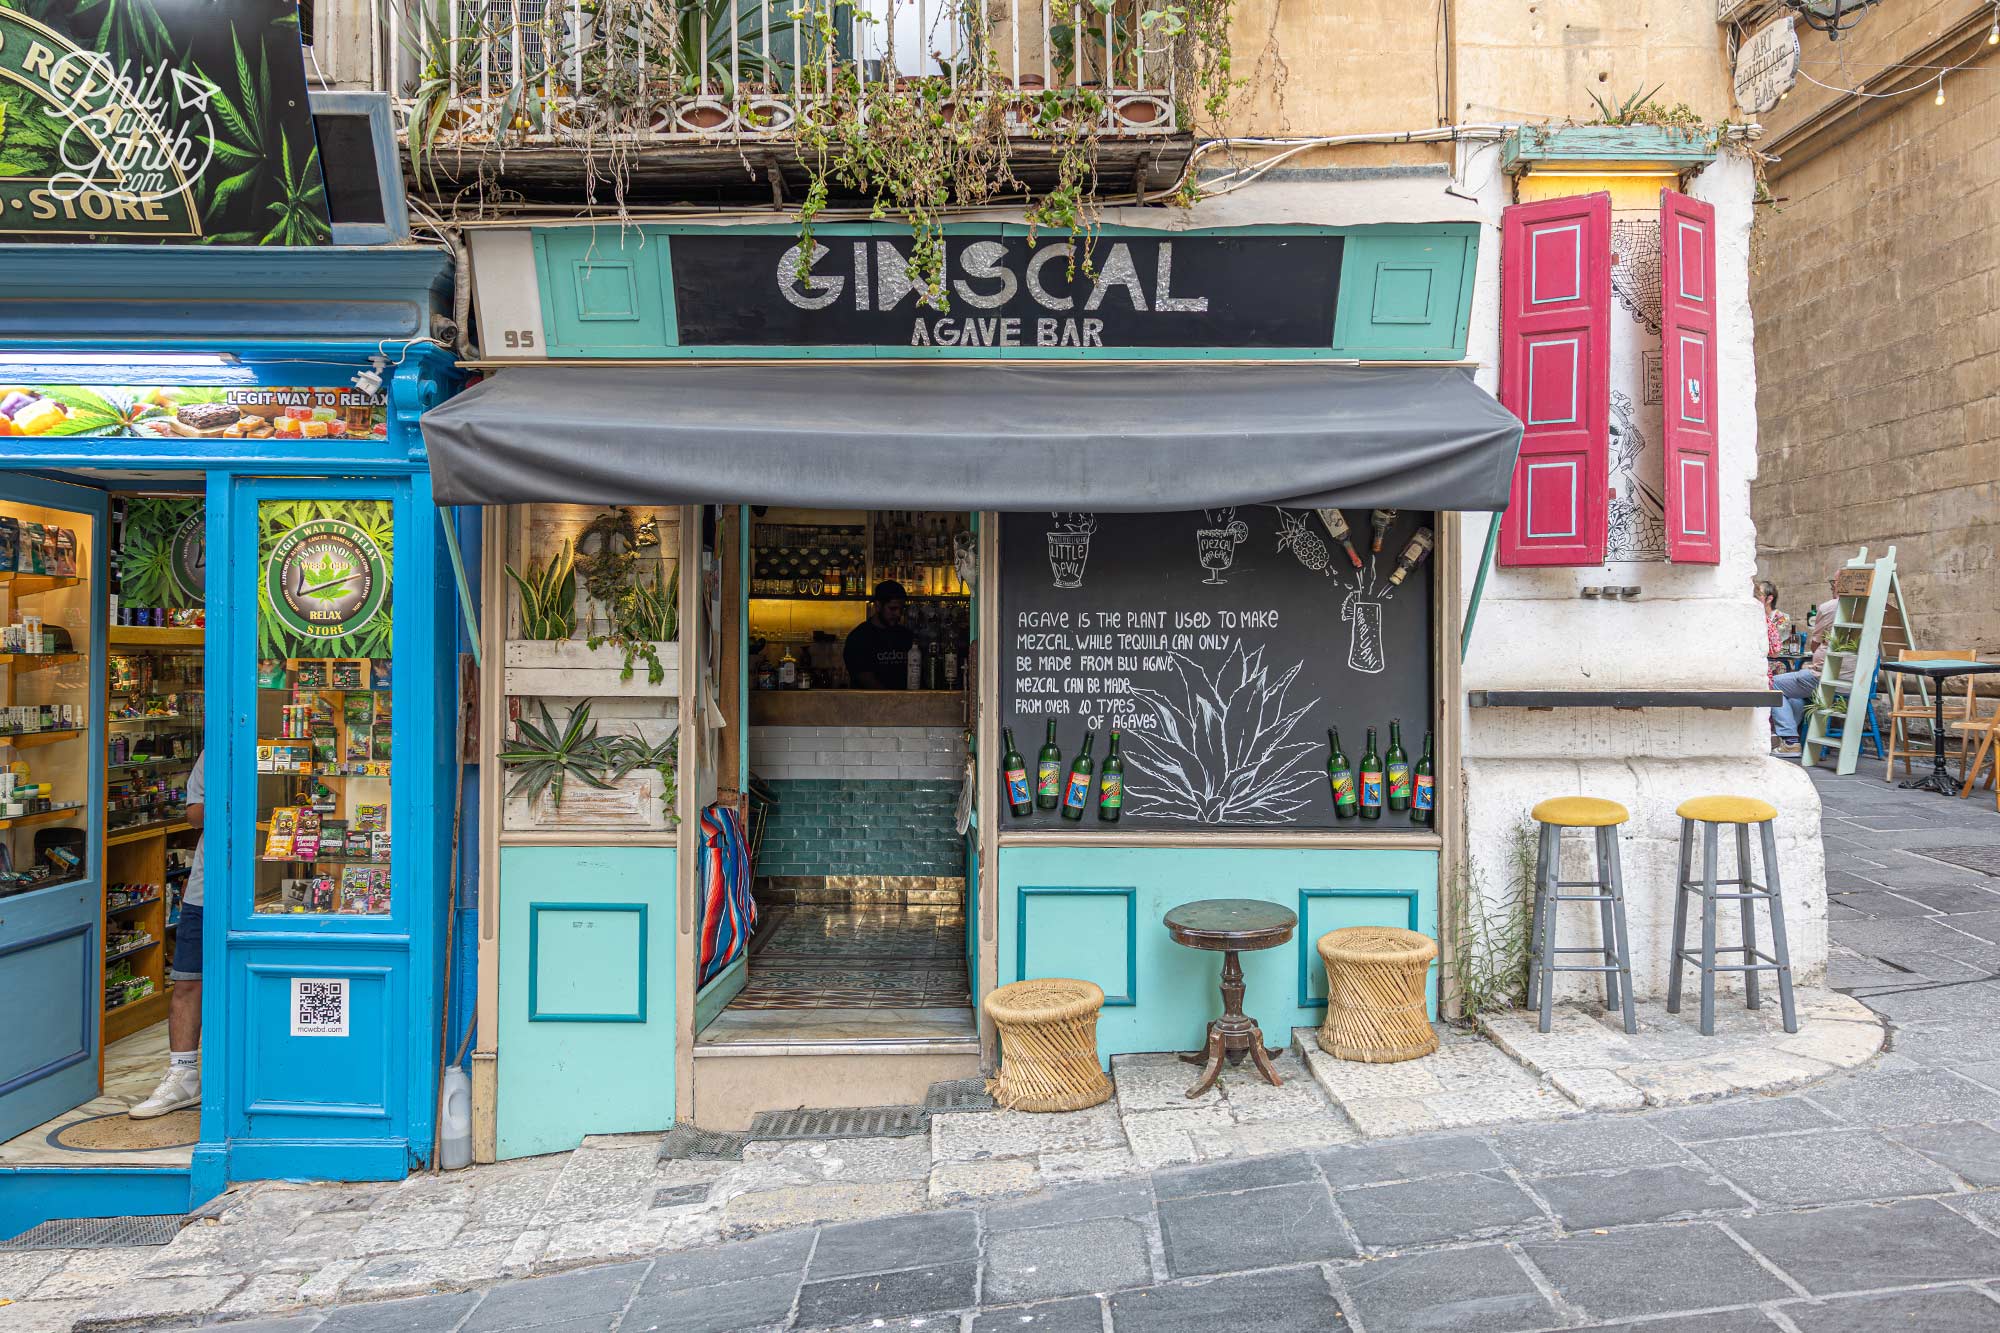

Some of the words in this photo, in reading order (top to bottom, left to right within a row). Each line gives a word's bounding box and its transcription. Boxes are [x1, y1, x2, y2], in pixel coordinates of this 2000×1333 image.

[1753, 29, 1774, 61] ART
[29, 189, 170, 221] STORE
[776, 240, 1209, 312] GINSCAL
[504, 330, 534, 348] 95
[911, 317, 1021, 347] AGAVE
[1037, 318, 1104, 347] BAR
[227, 391, 273, 406] LEGIT
[276, 392, 311, 406] WAY
[315, 392, 336, 406] TO
[340, 393, 388, 407] RELAX
[275, 534, 299, 562] LEGIT
[303, 524, 326, 536] WAY
[332, 524, 347, 535] TO
[351, 532, 379, 561] RELAX
[309, 611, 342, 620] RELAX
[1078, 612, 1091, 628] IS
[1127, 611, 1168, 629] PLANT
[1217, 610, 1237, 629] TO
[306, 624, 346, 636] STORE
[1172, 633, 1194, 651] CAN
[1199, 633, 1230, 651] ONLY
[1081, 655, 1113, 672] FROM
[1118, 655, 1138, 672] BLU
[1064, 677, 1084, 694] CAN
[1015, 698, 1042, 714] FROM
[1078, 699, 1092, 716] 40
[1087, 715, 1105, 730] OF
